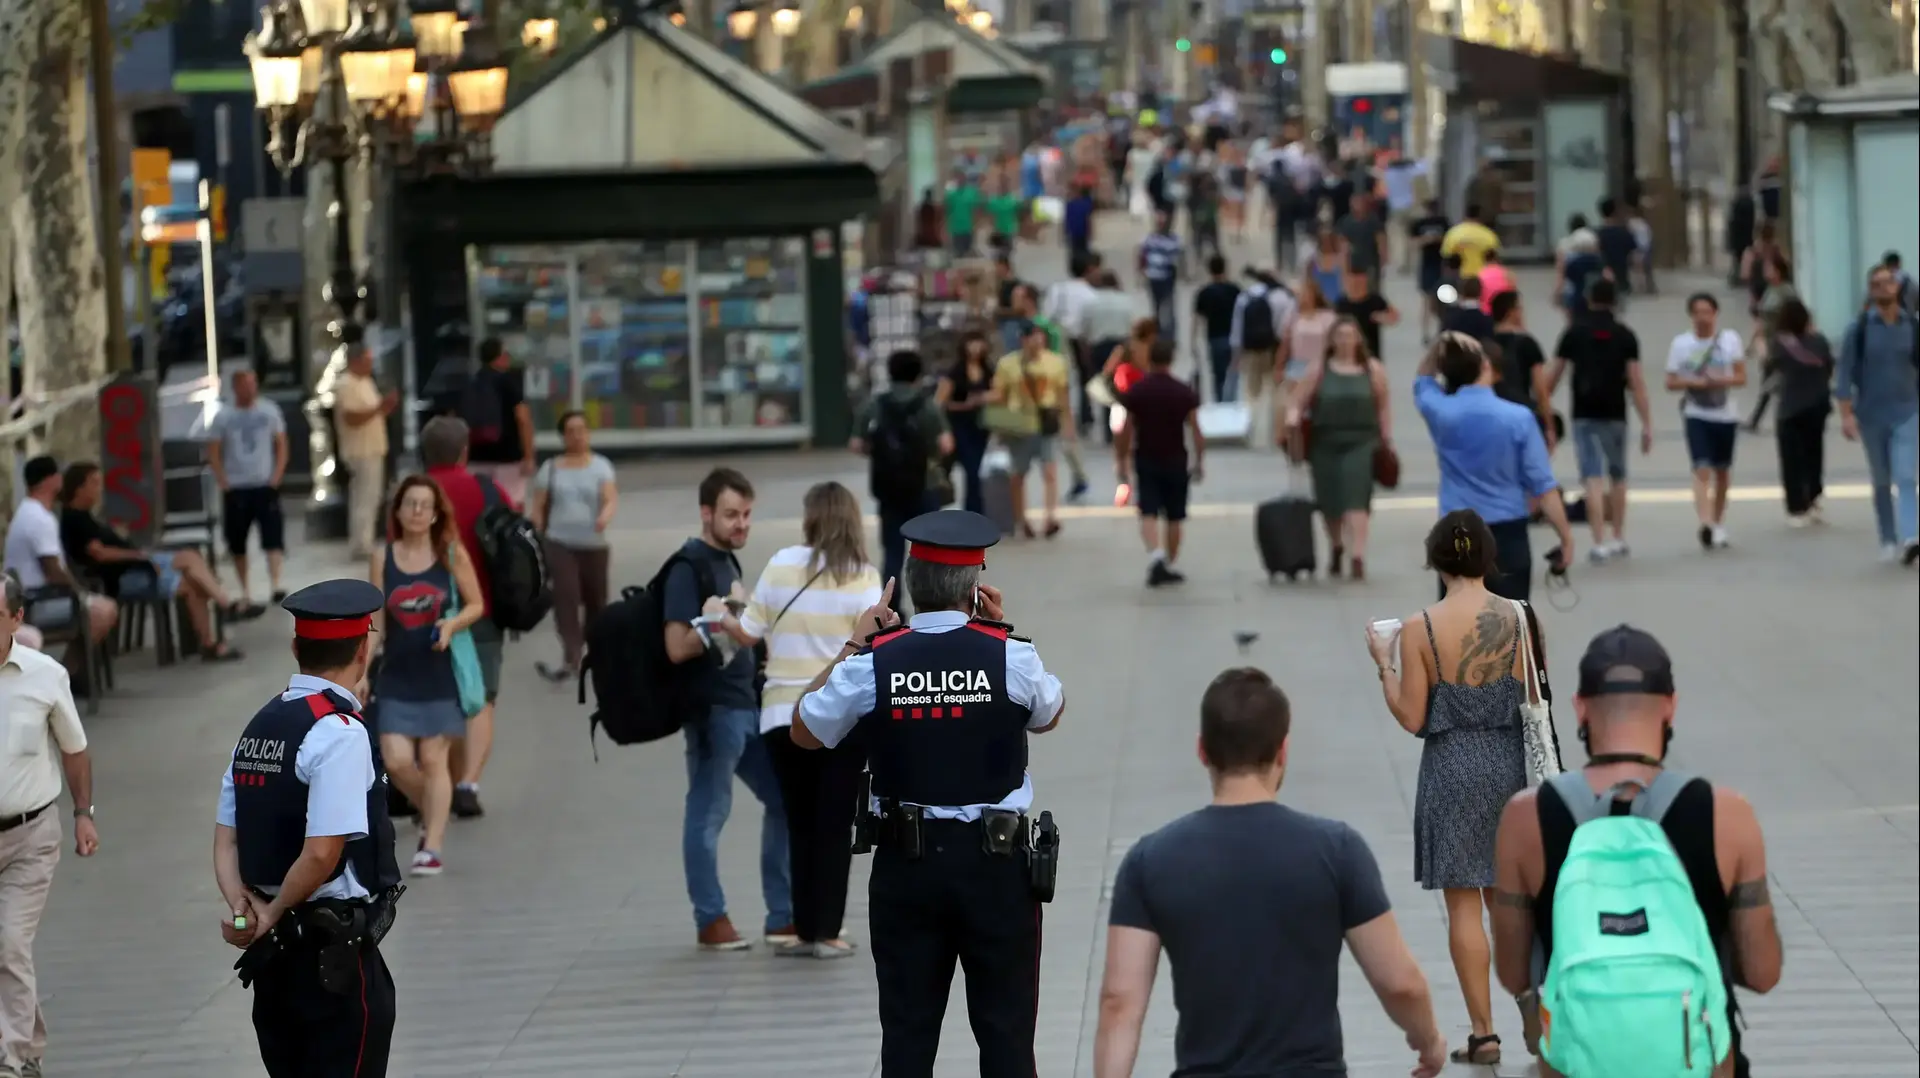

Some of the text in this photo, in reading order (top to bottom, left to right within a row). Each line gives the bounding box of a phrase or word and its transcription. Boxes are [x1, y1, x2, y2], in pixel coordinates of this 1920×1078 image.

[891, 670, 991, 693] POLICIA
[891, 696, 931, 705] mossos
[236, 737, 285, 760] POLICIA
